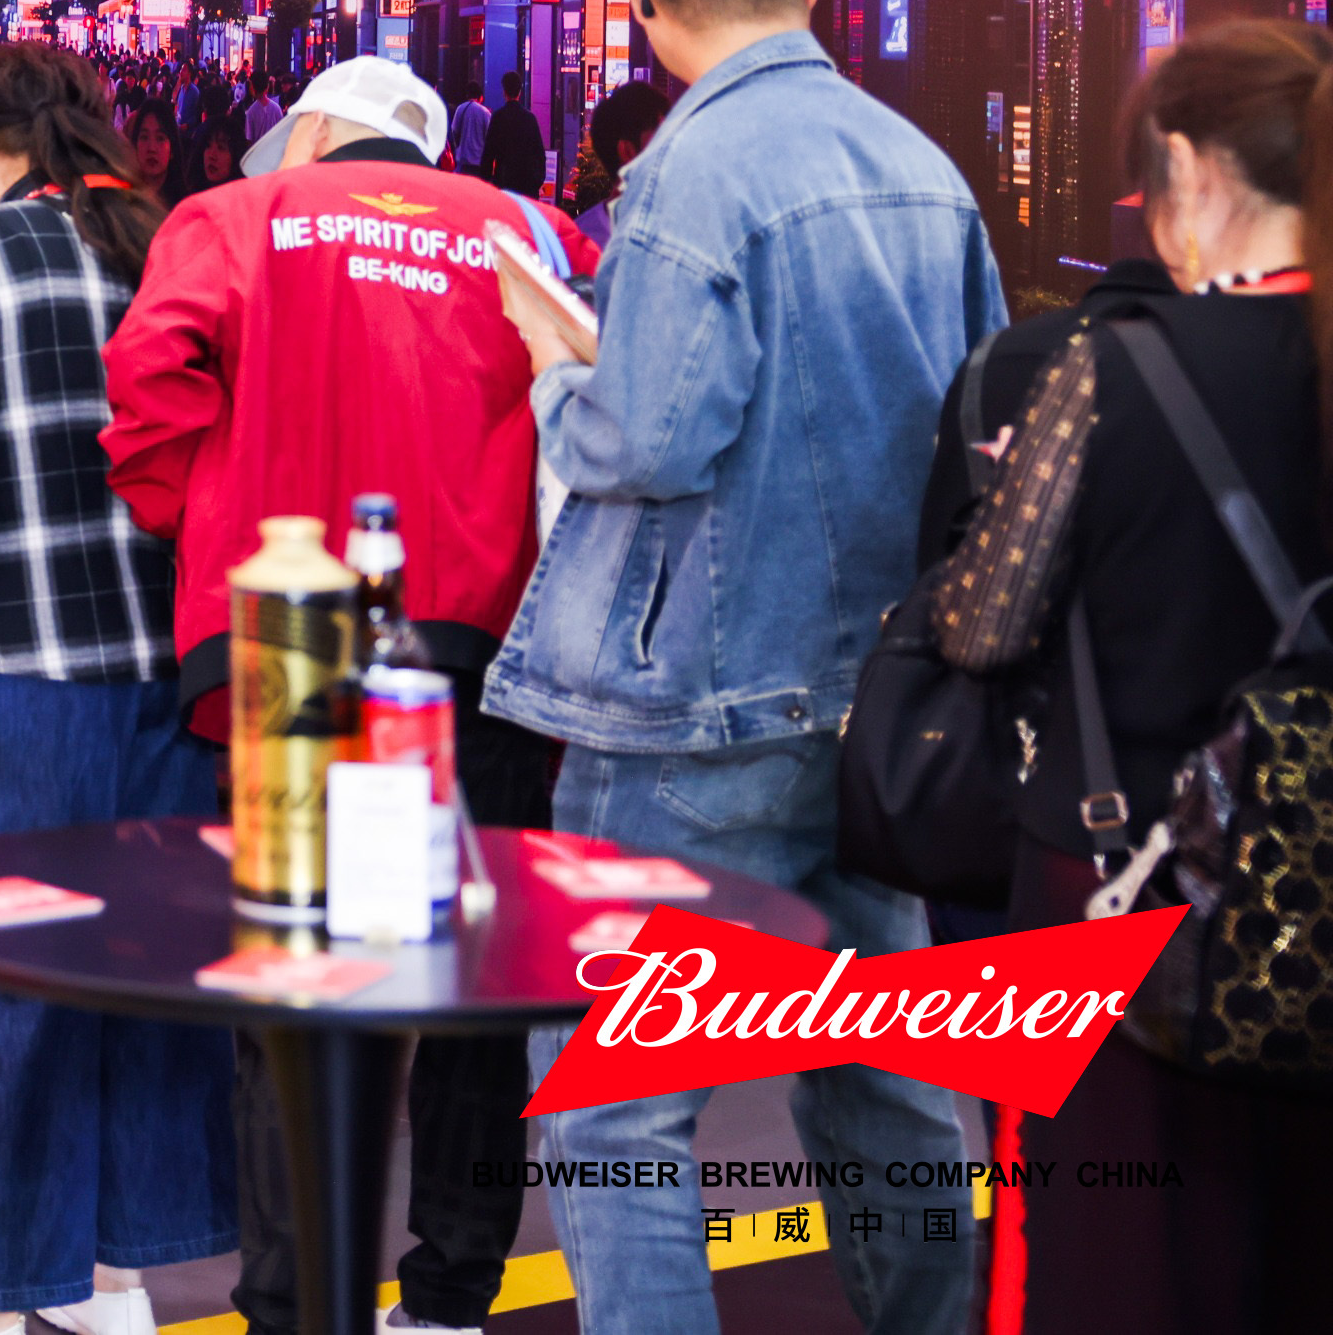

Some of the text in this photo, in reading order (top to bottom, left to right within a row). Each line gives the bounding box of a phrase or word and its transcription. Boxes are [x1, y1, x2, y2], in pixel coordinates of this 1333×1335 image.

[316, 214, 409, 252] SPIRIT
[410, 227, 448, 259] OF
[348, 255, 449, 295] BE-KING
